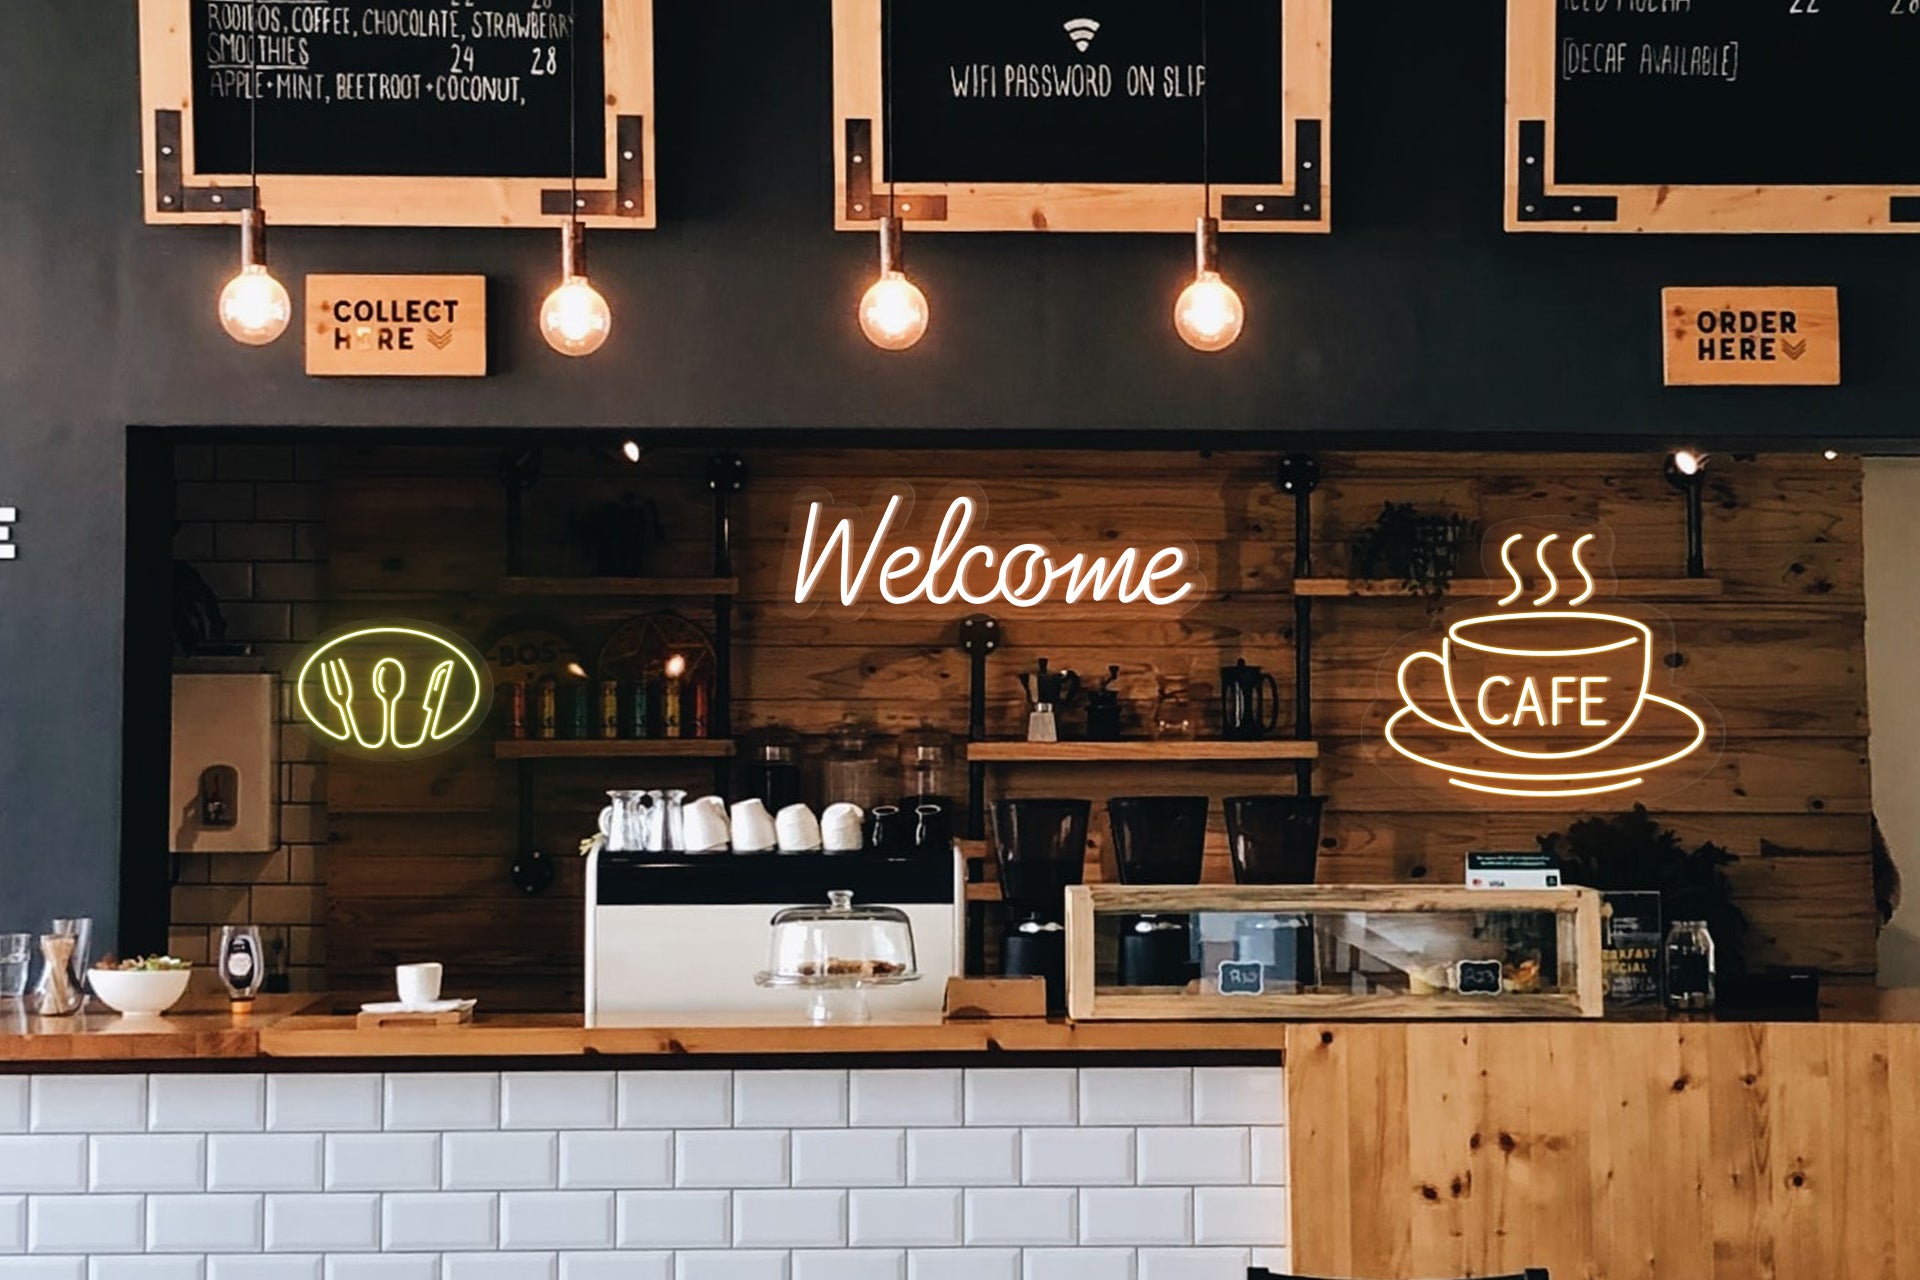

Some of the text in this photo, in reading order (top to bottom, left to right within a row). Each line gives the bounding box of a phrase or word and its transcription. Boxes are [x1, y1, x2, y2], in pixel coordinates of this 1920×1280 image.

[291, 6, 358, 37] COFFEE,
[362, 9, 466, 42] CHOCOLATE,
[449, 43, 479, 75] 24
[529, 46, 558, 76] 28
[950, 64, 997, 98] WIFI
[1005, 64, 1112, 98] PASSWORD
[1127, 65, 1155, 97] ON
[333, 300, 459, 323] COLLECT
[1697, 310, 1797, 334] ORDER
[334, 327, 414, 350] HRE
[1698, 337, 1776, 361] HERE
[794, 494, 1196, 608] Welcome
[1477, 675, 1611, 727] CAFE
